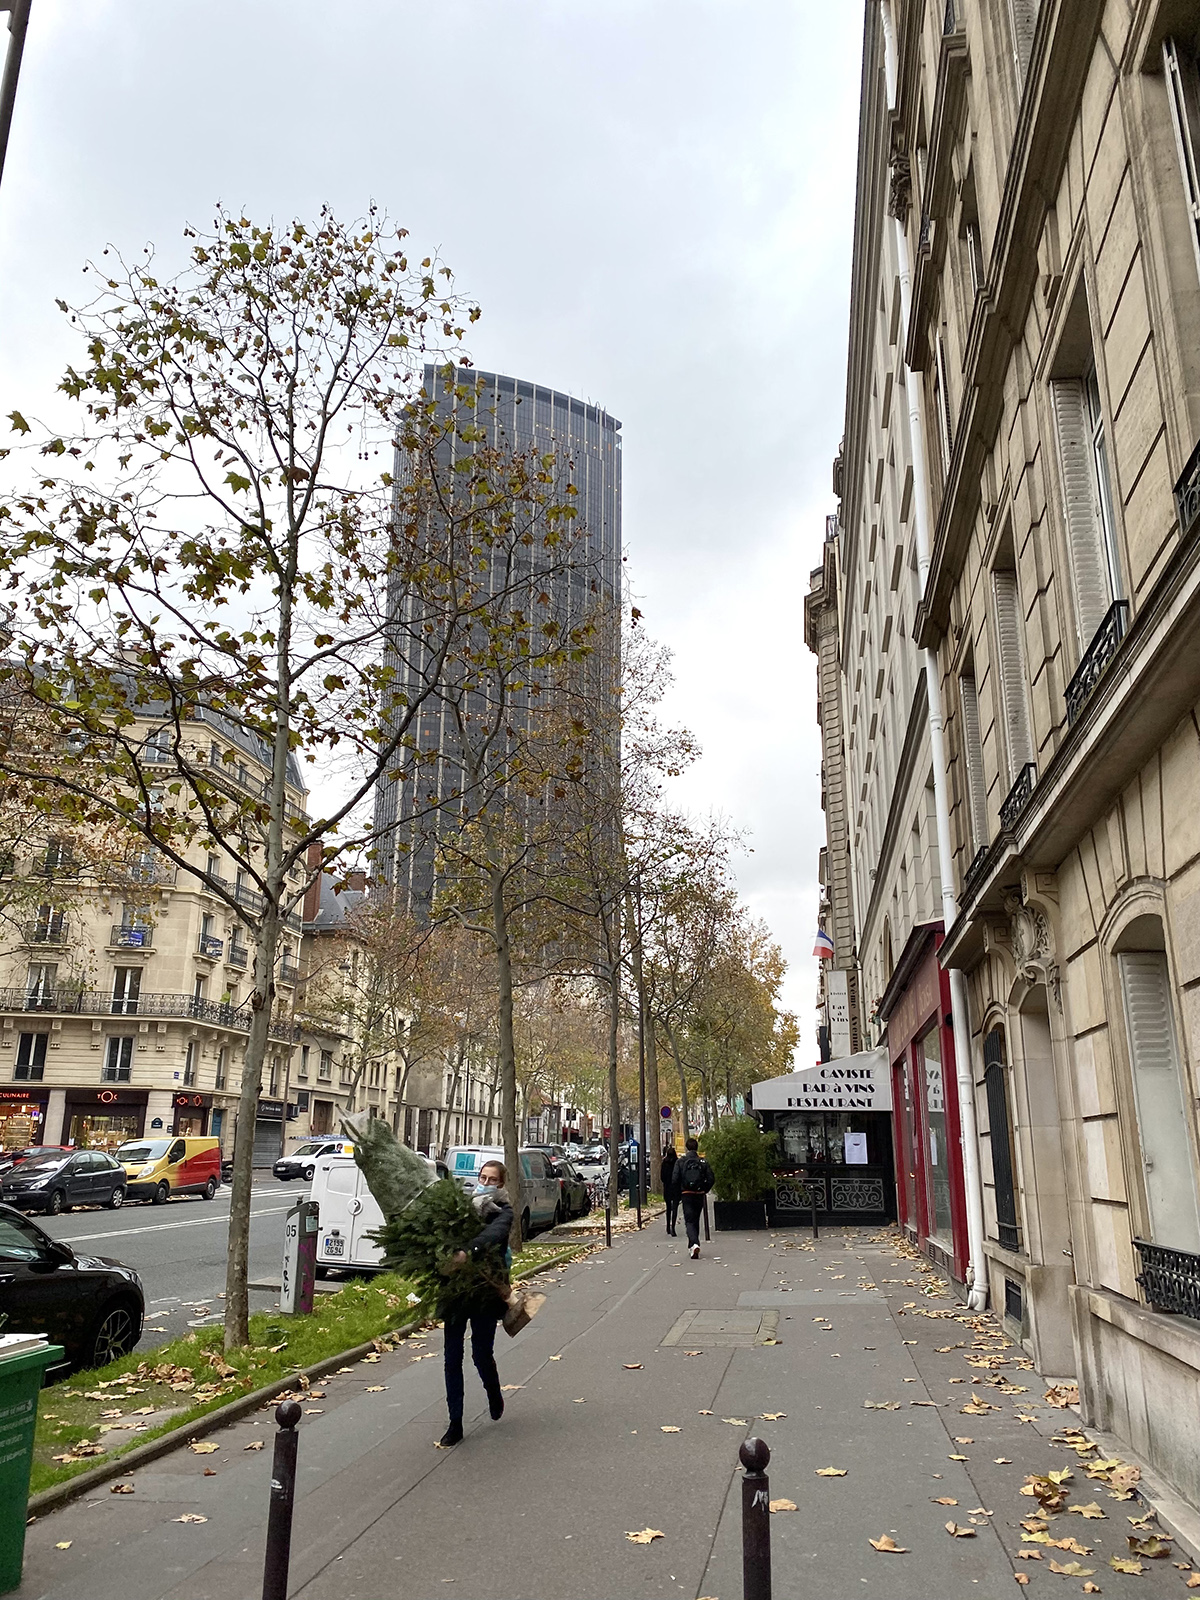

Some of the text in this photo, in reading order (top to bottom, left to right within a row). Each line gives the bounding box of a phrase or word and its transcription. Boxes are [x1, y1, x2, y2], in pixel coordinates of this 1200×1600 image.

[820, 1069, 874, 1079] CAVISTE
[803, 1083, 876, 1093] BAR à VINS
[787, 1097, 873, 1108] RESTAURANT
[286, 1224, 297, 1238] 05
